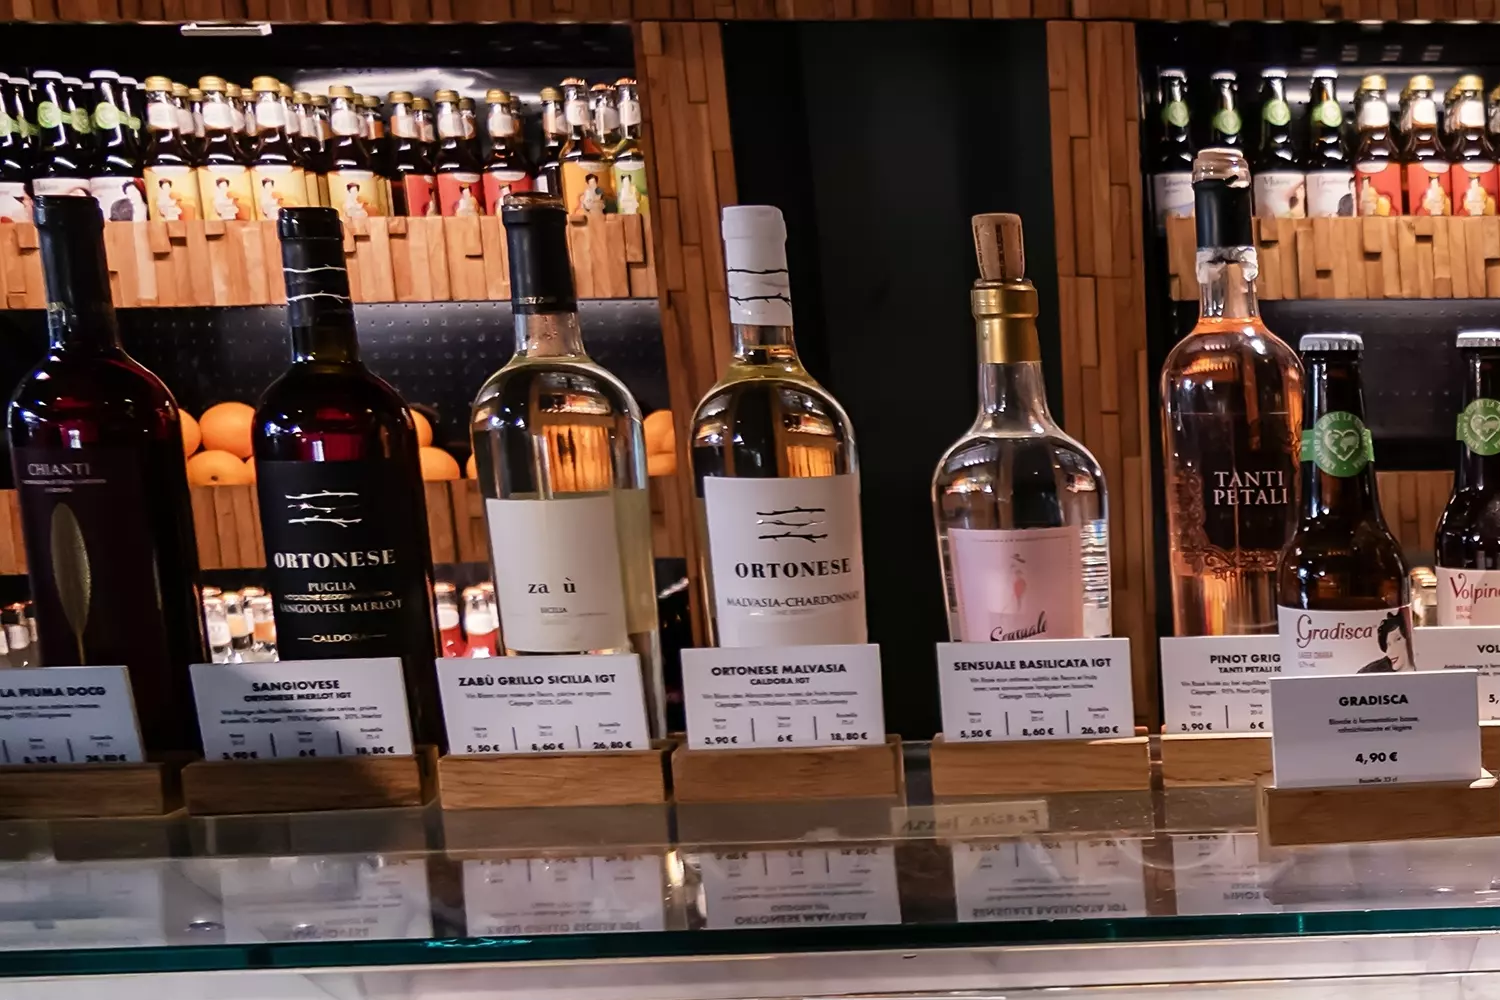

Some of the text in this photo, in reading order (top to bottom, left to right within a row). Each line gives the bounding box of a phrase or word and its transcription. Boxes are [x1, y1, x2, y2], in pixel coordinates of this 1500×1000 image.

[27, 463, 91, 476] CHIANTI
[1214, 471, 1284, 487] TANTI
[1214, 488, 1288, 505] PETALI
[274, 549, 396, 569] ORTONESE
[735, 558, 852, 578] ORTONESE
[308, 582, 356, 592] PUGLIA
[350, 599, 402, 613] MERLOT
[1296, 614, 1373, 648] Gradisca
[954, 658, 1112, 671] SENSUALE BASILICATA IGT
[1210, 654, 1281, 663] PINOT GRIG
[711, 663, 847, 676] ORTONESE MALVASIA
[252, 680, 340, 692] SANGIOVESE
[458, 674, 616, 686] ZABÙ GRILLO SICILIA IGT
[750, 678, 793, 686] CALDORA
[66, 687, 105, 696] DOCG
[1339, 694, 1408, 707] GRADISCA
